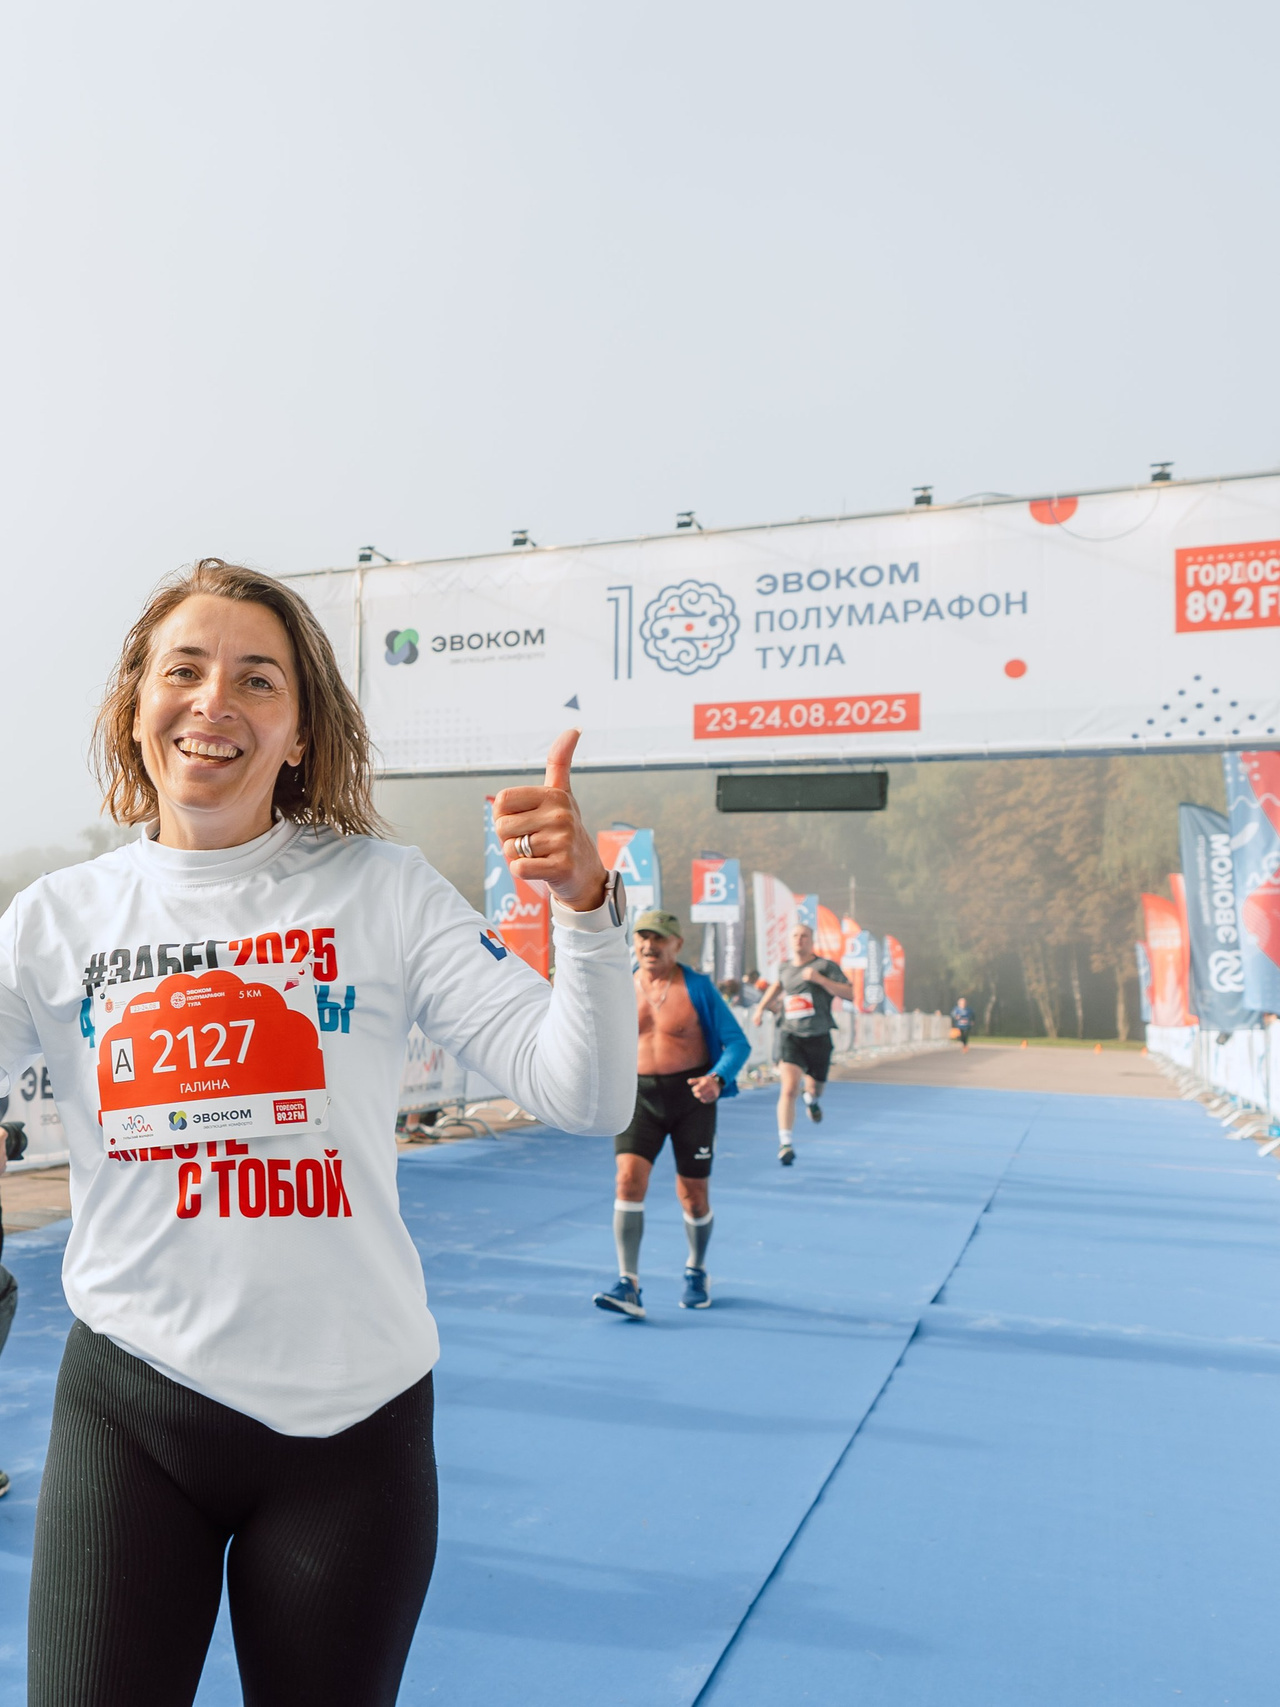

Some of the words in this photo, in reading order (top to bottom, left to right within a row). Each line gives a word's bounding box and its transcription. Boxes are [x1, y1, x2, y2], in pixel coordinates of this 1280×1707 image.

[756, 561, 920, 596] ЭВОКОМ
[755, 591, 1028, 634] ПОЛУМАРАФОН
[1185, 586, 1254, 623] 89.2
[1259, 584, 1280, 618] F
[431, 628, 545, 652] ЭВОКОМ
[756, 642, 846, 669] ТУЛА
[705, 699, 907, 732] 23-24.08.2025
[239, 990, 244, 999] 5
[149, 1019, 256, 1074] 2127
[180, 1078, 230, 1094] ГАЛИНА
[192, 1109, 252, 1124] ЭВОКОМ
[276, 1112, 293, 1121] 89.2
[293, 1110, 305, 1120] FM
[176, 1161, 202, 1219] С
[211, 1149, 353, 1219] ТОБОЙ
